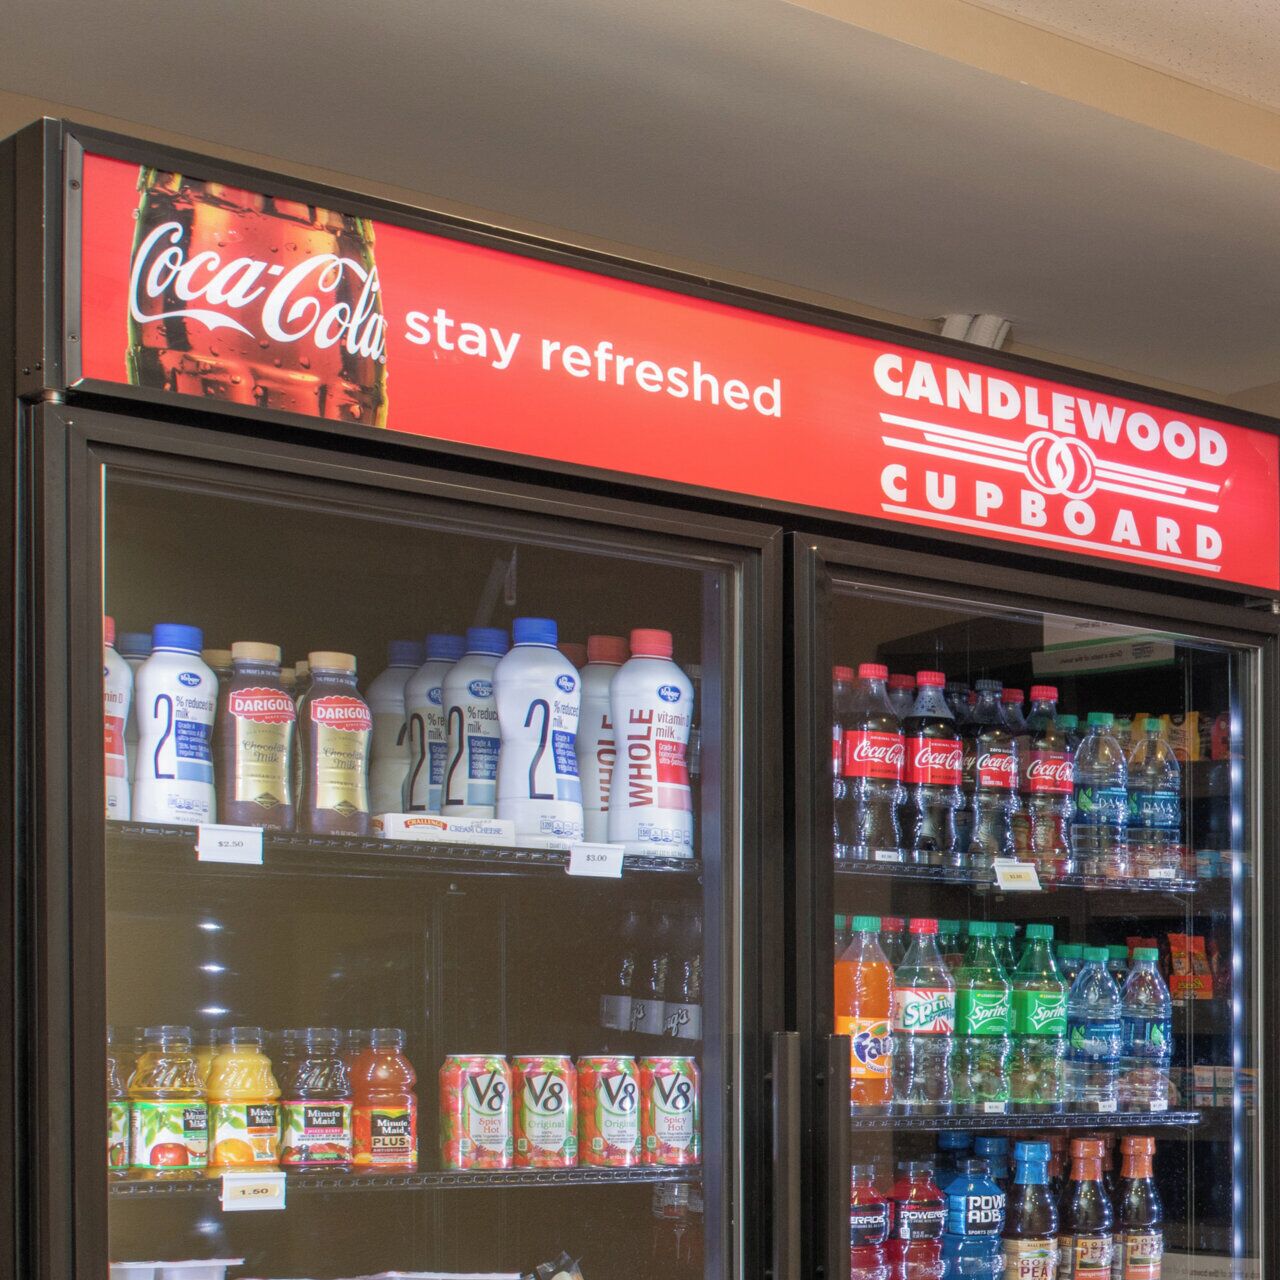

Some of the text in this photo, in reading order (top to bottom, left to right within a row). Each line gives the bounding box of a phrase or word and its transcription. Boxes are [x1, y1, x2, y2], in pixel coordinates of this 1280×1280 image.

[130, 221, 386, 363] Coca-Cola
[404, 308, 782, 418] stay refreshed
[873, 353, 1228, 468] CANDLEWOOD
[880, 463, 1223, 561] CUPBOARD
[235, 699, 294, 712] DARIGOLD
[317, 706, 372, 720] DARIGOLD
[154, 694, 175, 779] 2
[656, 726, 676, 739] milk
[524, 698, 554, 800] 2
[629, 708, 654, 808] WHOLE
[586, 854, 607, 862] $3.00
[972, 1006, 1008, 1020] Sprite
[469, 1070, 506, 1111] V8
[526, 1071, 563, 1111] V8
[601, 1072, 635, 1111] V8
[654, 1072, 692, 1110] V8
[308, 1109, 340, 1118] Minute
[313, 1117, 336, 1125] Maid
[377, 1119, 408, 1127] Minute
[664, 1116, 686, 1125] Spicy
[373, 1138, 406, 1146] PLUS
[382, 1126, 404, 1134] Maid
